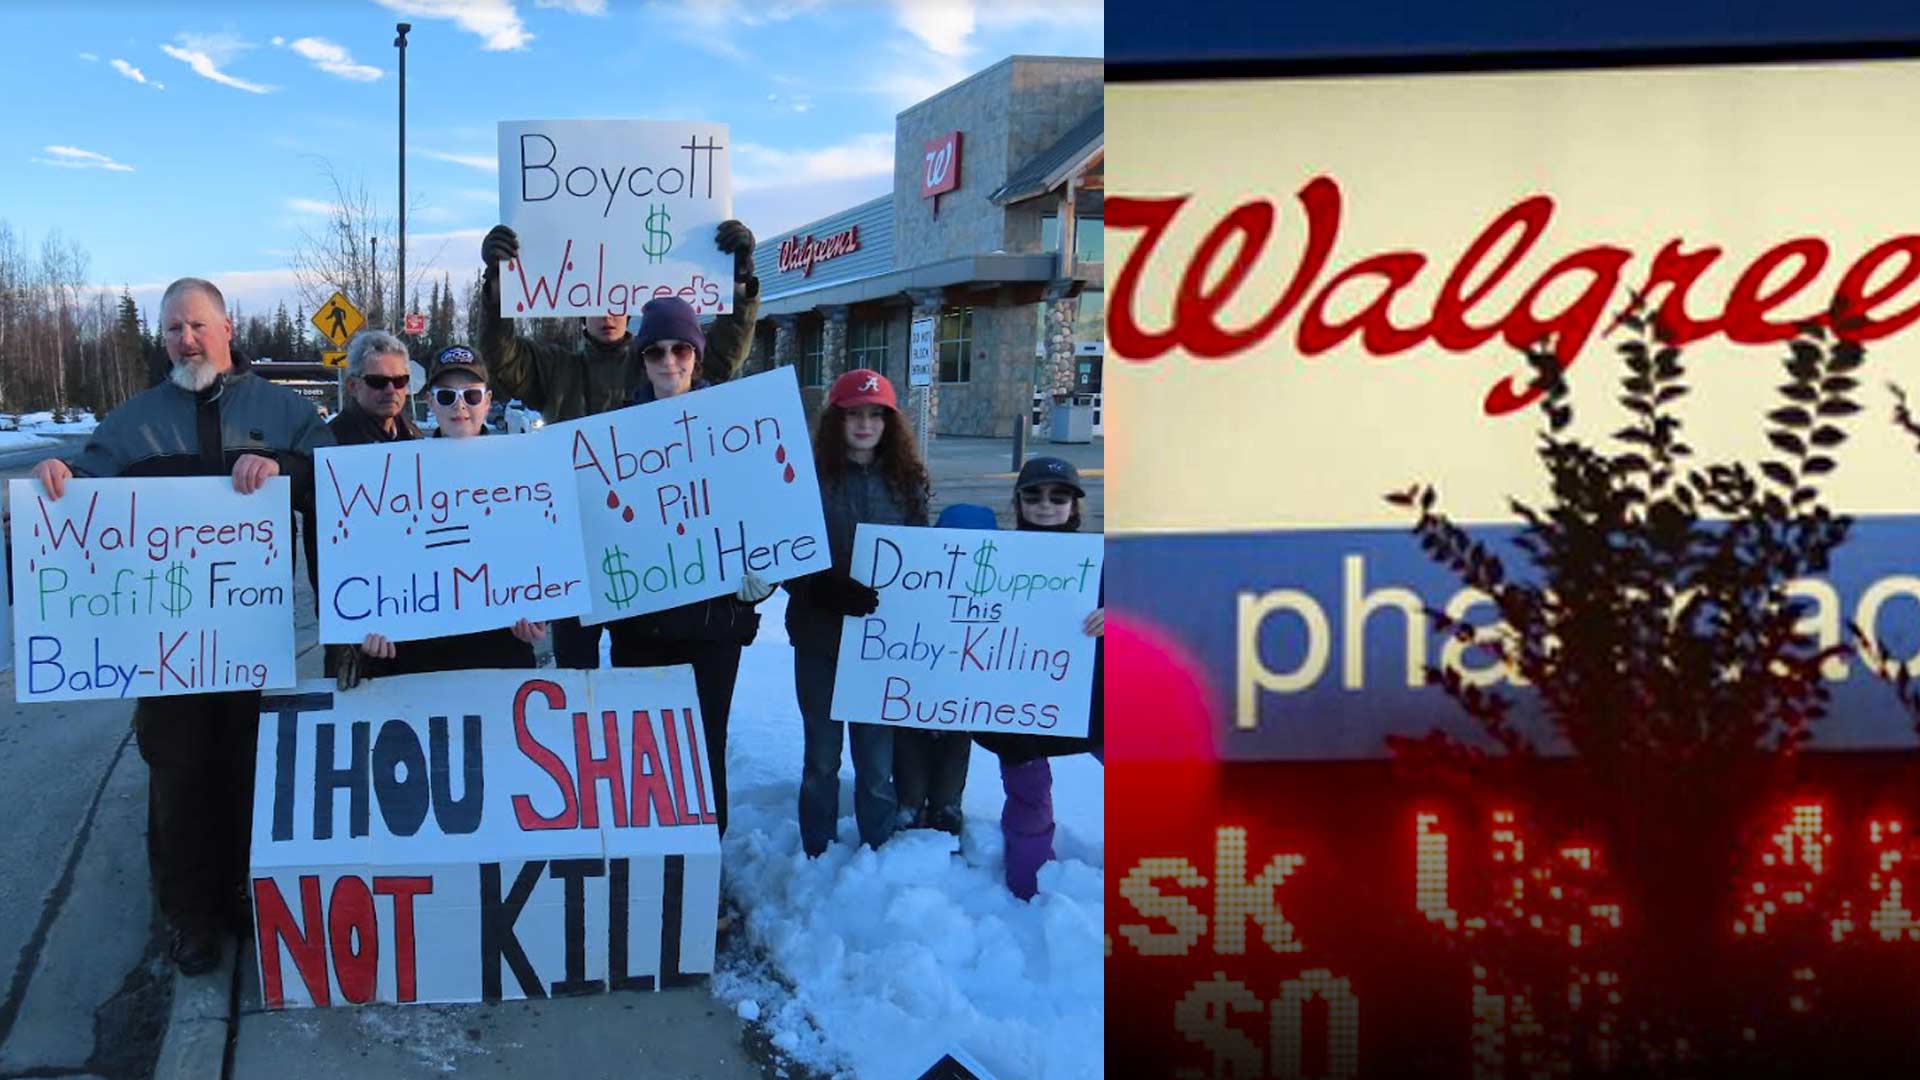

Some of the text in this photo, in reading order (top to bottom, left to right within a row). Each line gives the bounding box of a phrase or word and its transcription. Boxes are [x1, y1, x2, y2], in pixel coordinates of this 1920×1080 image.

[520, 134, 724, 218] Boycott
[926, 141, 953, 188] W
[642, 203, 673, 265] $
[777, 224, 861, 278] Walgreens
[1104, 176, 1920, 417] Walgree
[858, 376, 880, 391] A
[573, 410, 782, 485] Abortion
[326, 453, 553, 524] Walgreens
[658, 478, 711, 525] Pill
[37, 490, 274, 560] Walgreens
[38, 560, 283, 621] Profit$ From
[333, 563, 582, 621] Child Murder
[604, 521, 817, 610] $old Here
[871, 538, 1096, 602] Don't $upport
[948, 596, 1003, 621] This
[1236, 555, 1920, 728] phaac
[28, 630, 268, 698] Baby-Killing
[860, 617, 1070, 681] Baby-Killing
[881, 676, 1060, 729] Business
[259, 679, 718, 841] THOU SHALL
[1104, 827, 1304, 954] sk
[253, 854, 711, 1008] NOT KILL
